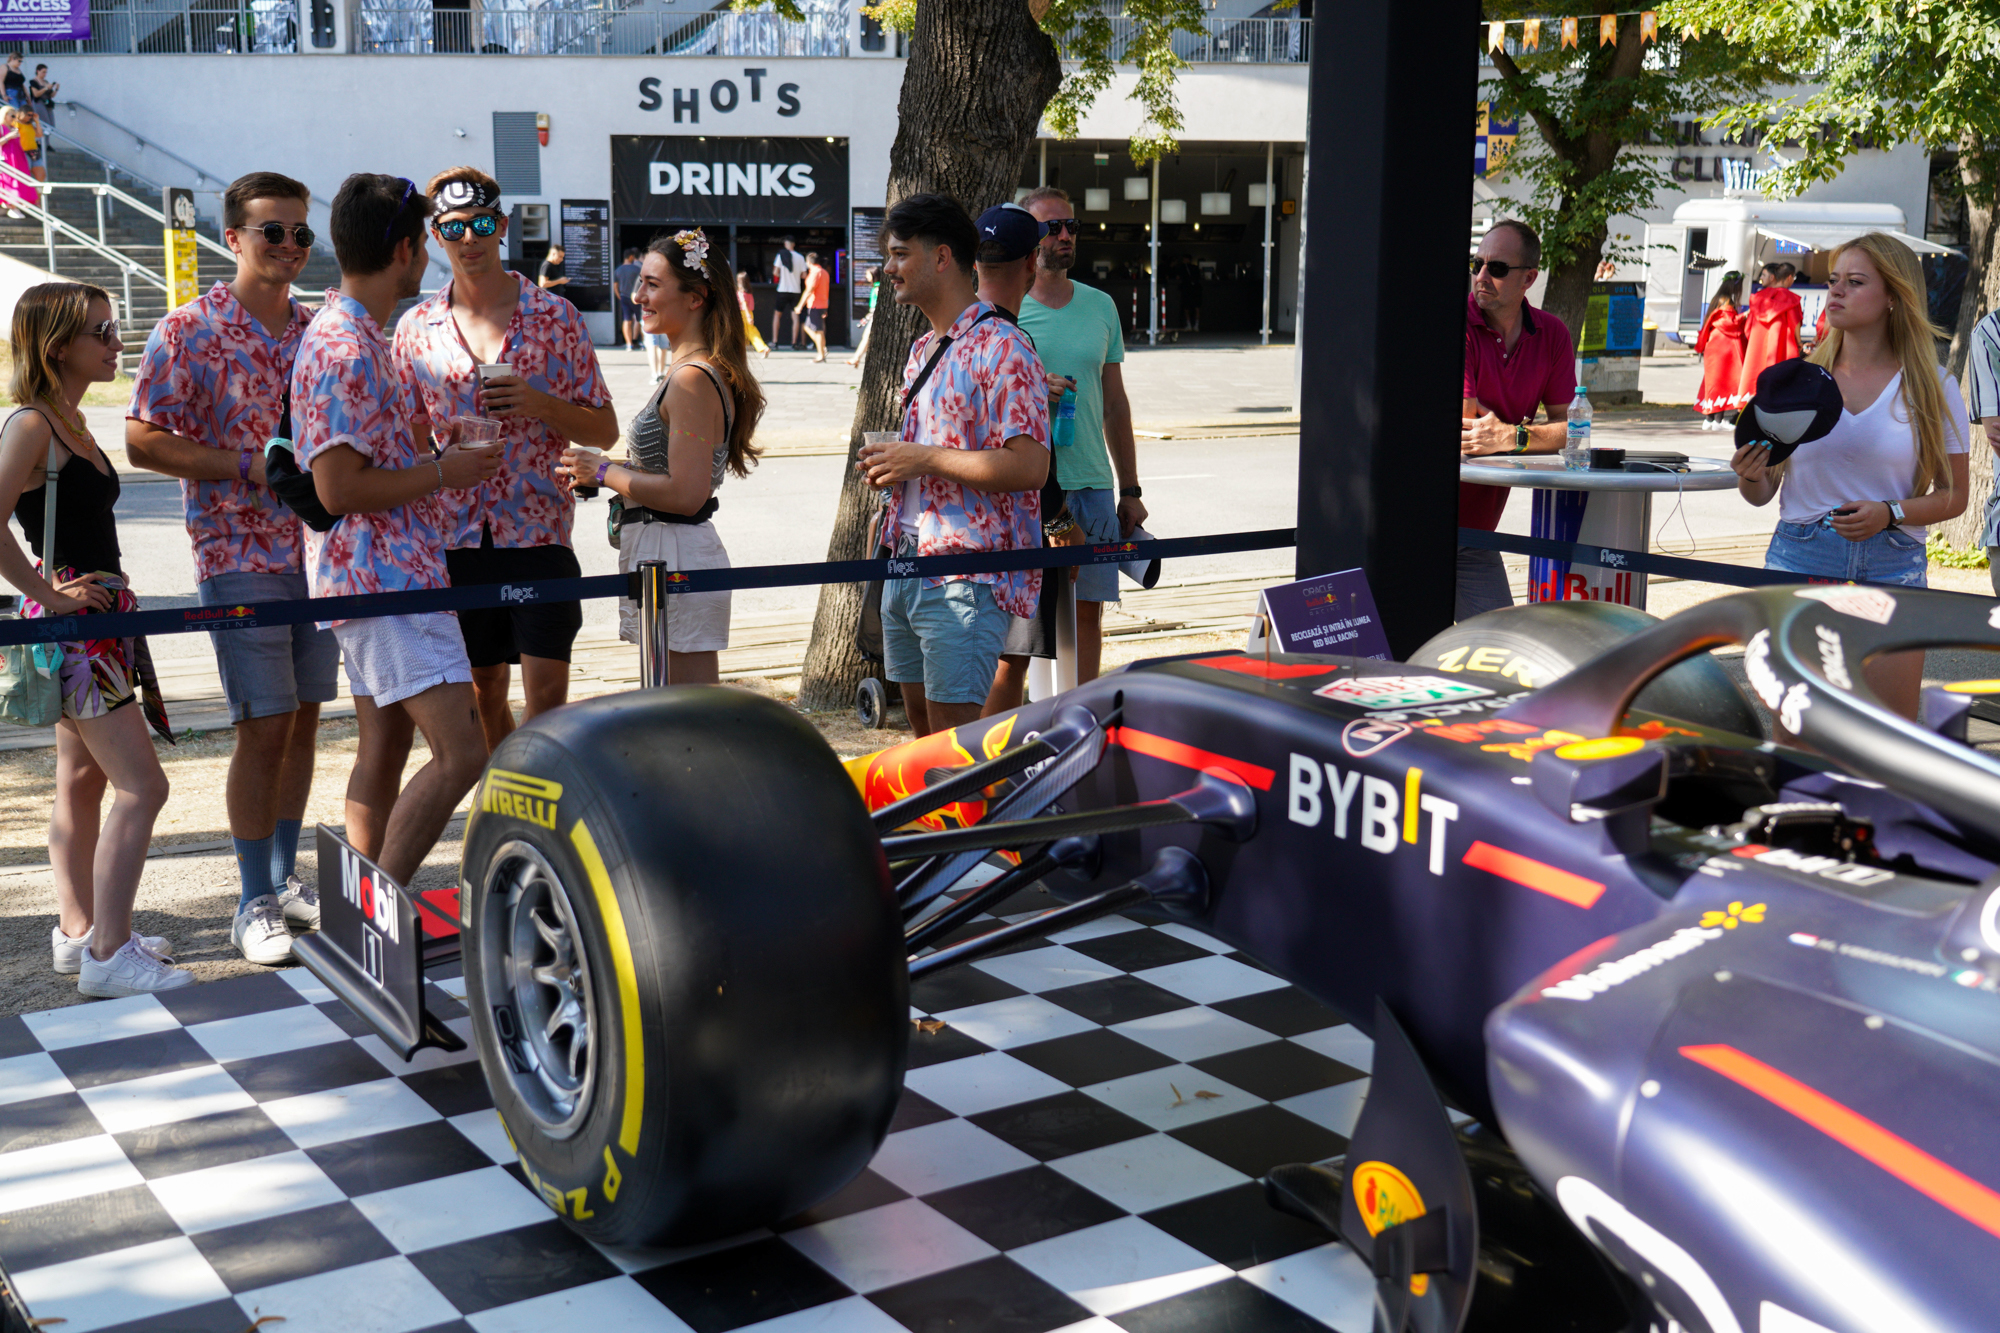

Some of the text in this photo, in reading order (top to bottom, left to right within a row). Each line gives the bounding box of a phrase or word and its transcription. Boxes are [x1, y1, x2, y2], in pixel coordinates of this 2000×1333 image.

[6, 0, 71, 12] ACCESS
[638, 68, 801, 124] SHOTS
[649, 161, 816, 197] DRINKS
[1093, 553, 1140, 562] RACING
[1302, 583, 1334, 597] ORACLE
[1529, 569, 1632, 606] ed Bull
[184, 608, 224, 621] Red Bull
[184, 620, 258, 632] RACING
[1309, 606, 1341, 616] RACING
[1290, 624, 1323, 642] RECICLEAZĂ
[1353, 614, 1372, 627] LUMEA
[1312, 629, 1359, 648] RED BULL RACING
[1438, 645, 1543, 688] ZER
[482, 767, 563, 831] PIRELLI
[1288, 752, 1459, 877] BYBIT
[341, 845, 400, 945] Mobil
[367, 934, 377, 978] 1
